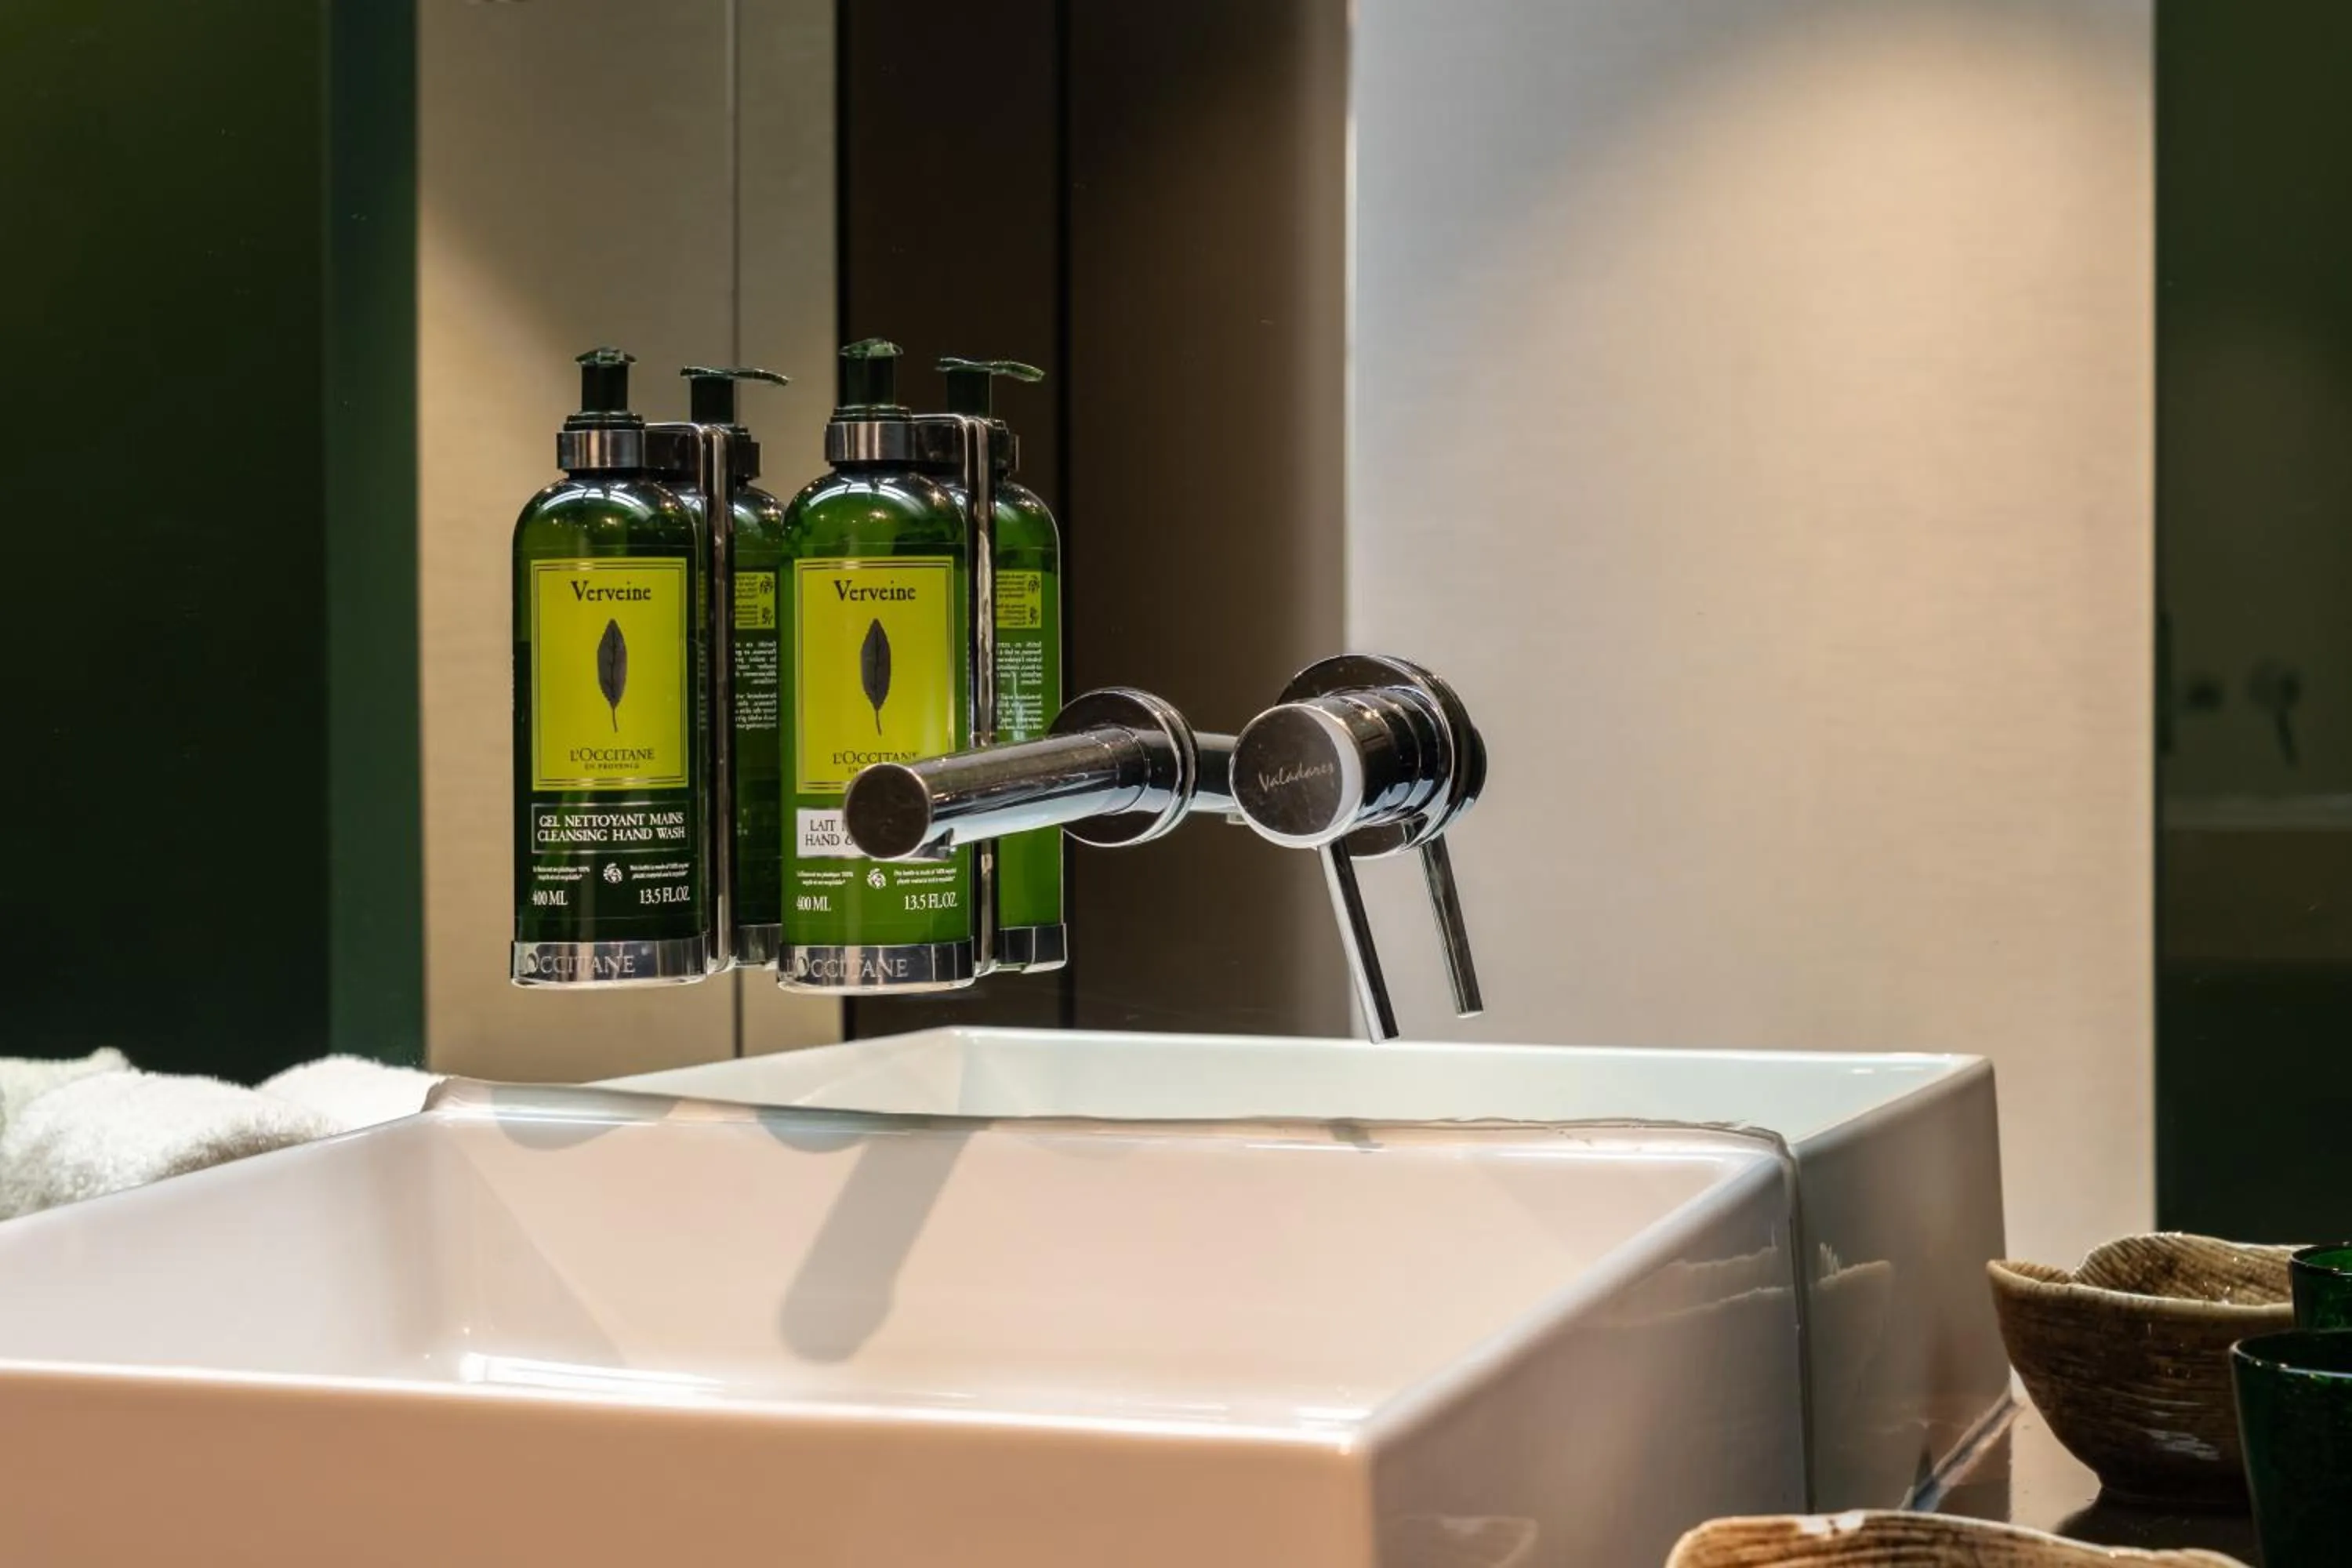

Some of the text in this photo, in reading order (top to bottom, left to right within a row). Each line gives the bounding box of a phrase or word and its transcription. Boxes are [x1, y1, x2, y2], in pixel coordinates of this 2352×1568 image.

[570, 580, 652, 601] Verveine
[833, 579, 916, 601] Verveine
[570, 747, 655, 762] L'OCCITANE
[1258, 761, 1334, 793] Valadares
[539, 812, 684, 827] GEL NETTOYANT MAINS
[810, 819, 836, 832] LAIT
[537, 826, 685, 842] CLEANSING HAND WASH
[805, 834, 840, 847] HAND
[532, 890, 568, 906] 400 ML
[639, 887, 660, 905] 13.5
[813, 895, 832, 912] ML
[904, 894, 926, 910] 13.5
